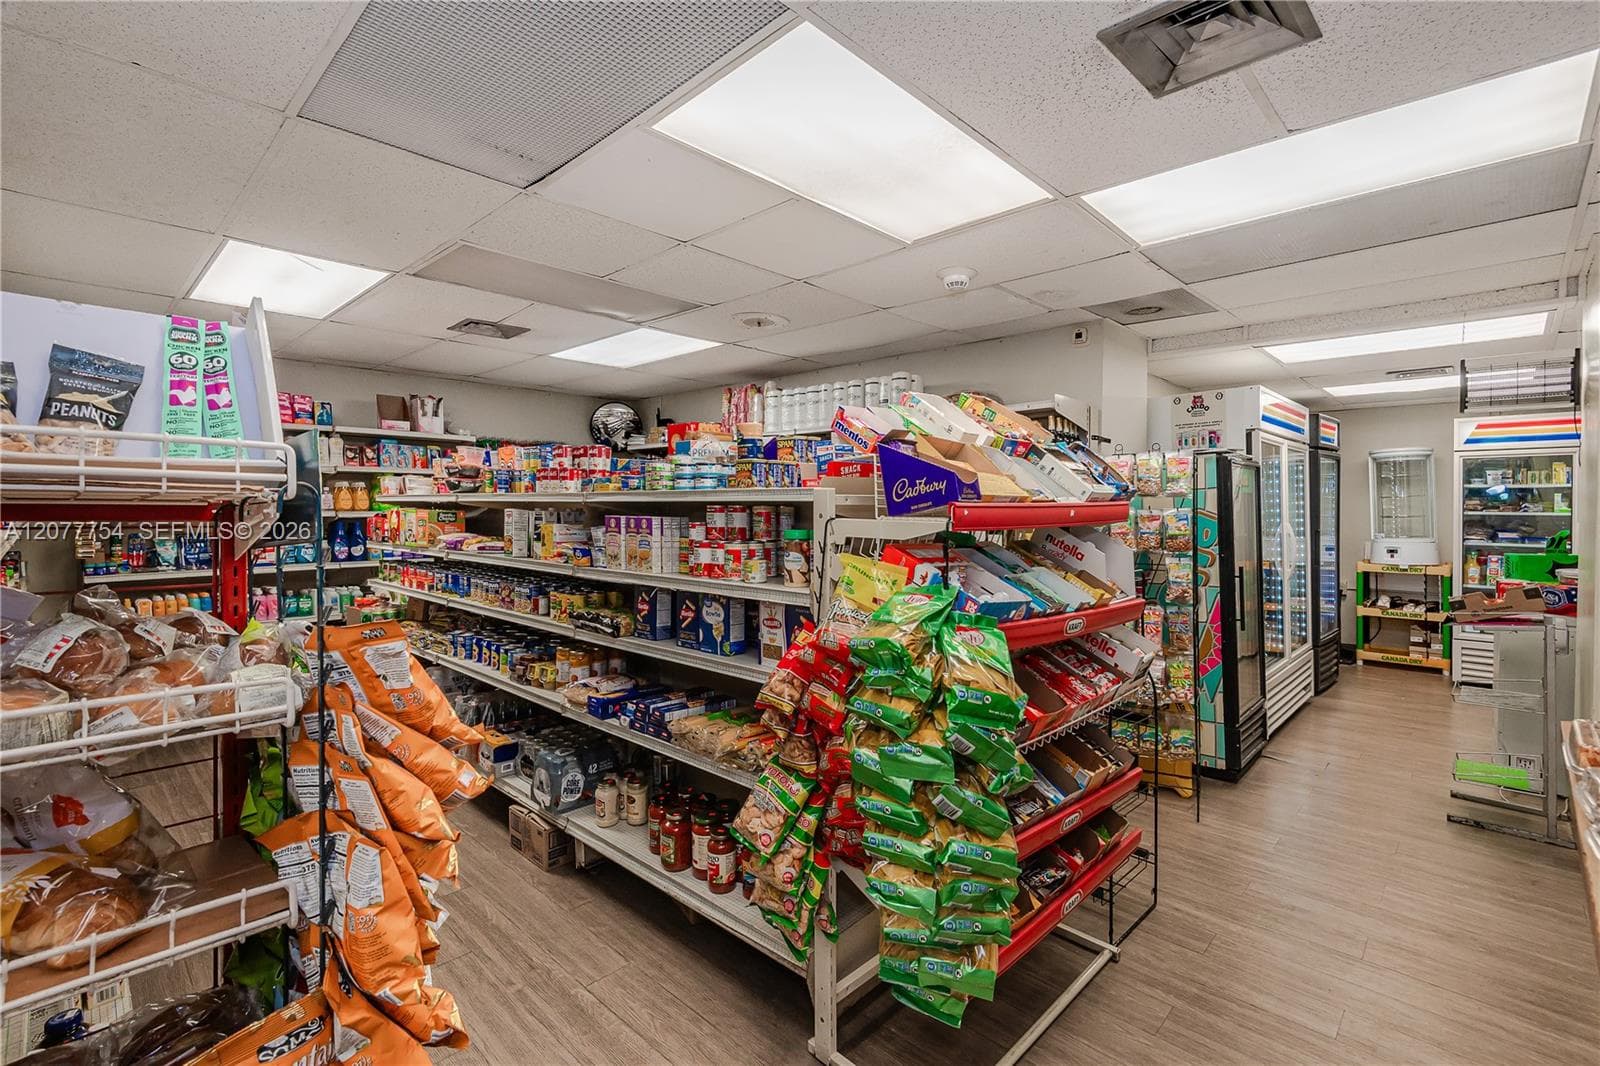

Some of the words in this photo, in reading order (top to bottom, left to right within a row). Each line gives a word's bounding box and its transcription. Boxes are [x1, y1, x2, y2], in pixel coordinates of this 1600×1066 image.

[49, 402, 118, 427] PEANUTS
[835, 420, 869, 450] mentos
[777, 440, 794, 448] SPAM
[736, 463, 752, 471] SPAM
[893, 477, 947, 502] Cadbury
[1045, 533, 1085, 561] nutella
[1381, 655, 1408, 663] CANADA
[563, 787, 581, 795] POWER
